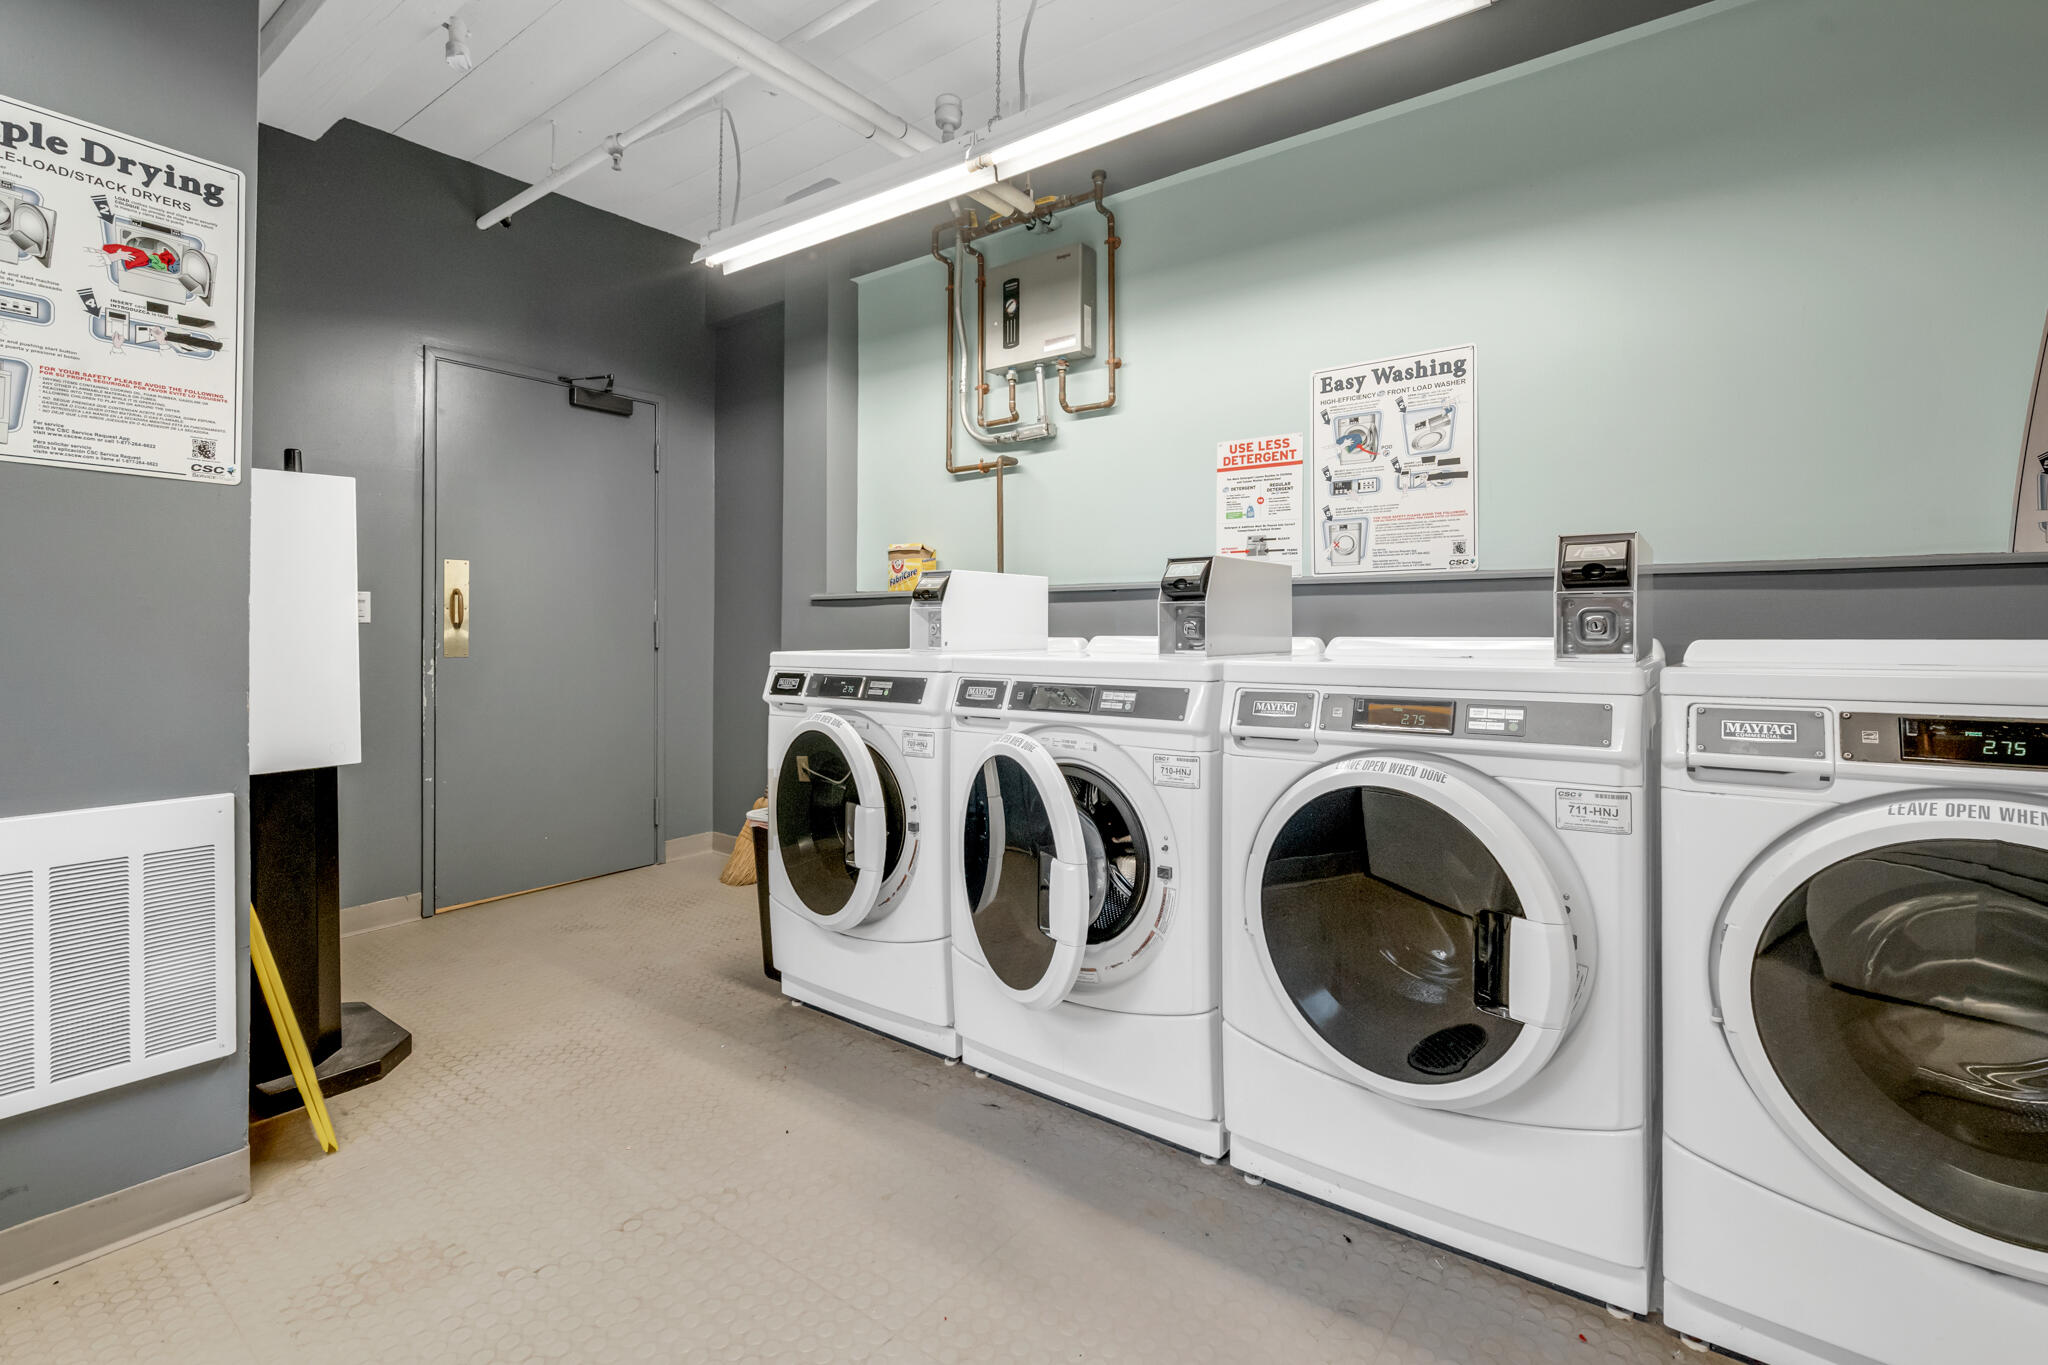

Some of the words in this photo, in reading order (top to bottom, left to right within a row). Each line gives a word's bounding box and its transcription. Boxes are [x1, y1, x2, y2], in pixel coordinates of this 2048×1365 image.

[80, 137, 224, 207] Drying
[0, 150, 126, 194] E-LOAD/STACK
[132, 187, 191, 212] DRYERS
[58, 368, 80, 376] YOUR
[83, 372, 111, 381] SAFETY
[114, 377, 142, 386] PLEASE
[185, 389, 224, 399] FOLLOWING
[1320, 375, 1366, 394] Easy
[1372, 358, 1466, 385] Washing
[1320, 393, 1375, 405] HIGH-EFFICIENCY
[1387, 387, 1410, 395] FRONT
[1435, 378, 1466, 388] WASHER
[1230, 442, 1254, 454] USE
[1258, 438, 1290, 451] LESS
[1223, 449, 1296, 466] DETERGENT
[191, 464, 224, 474] CSC
[889, 568, 918, 586] FabriCare
[968, 687, 995, 696] MAYTAG
[1255, 702, 1295, 712] MAYTAG
[1400, 714, 1425, 726] 2.75
[1725, 721, 1793, 736] MAYTAG
[1735, 732, 1782, 740] COMMERCIAL
[1982, 740, 2026, 756] 2.75
[1161, 766, 1192, 776] 710-HNJ
[1362, 760, 1387, 772] OPEN
[1388, 763, 1416, 778] WHEN
[1420, 769, 1449, 784] DONE
[1568, 804, 1619, 818] 711-HNJ
[1888, 802, 1938, 816] LEAVE
[1945, 803, 1990, 820] OPEN
